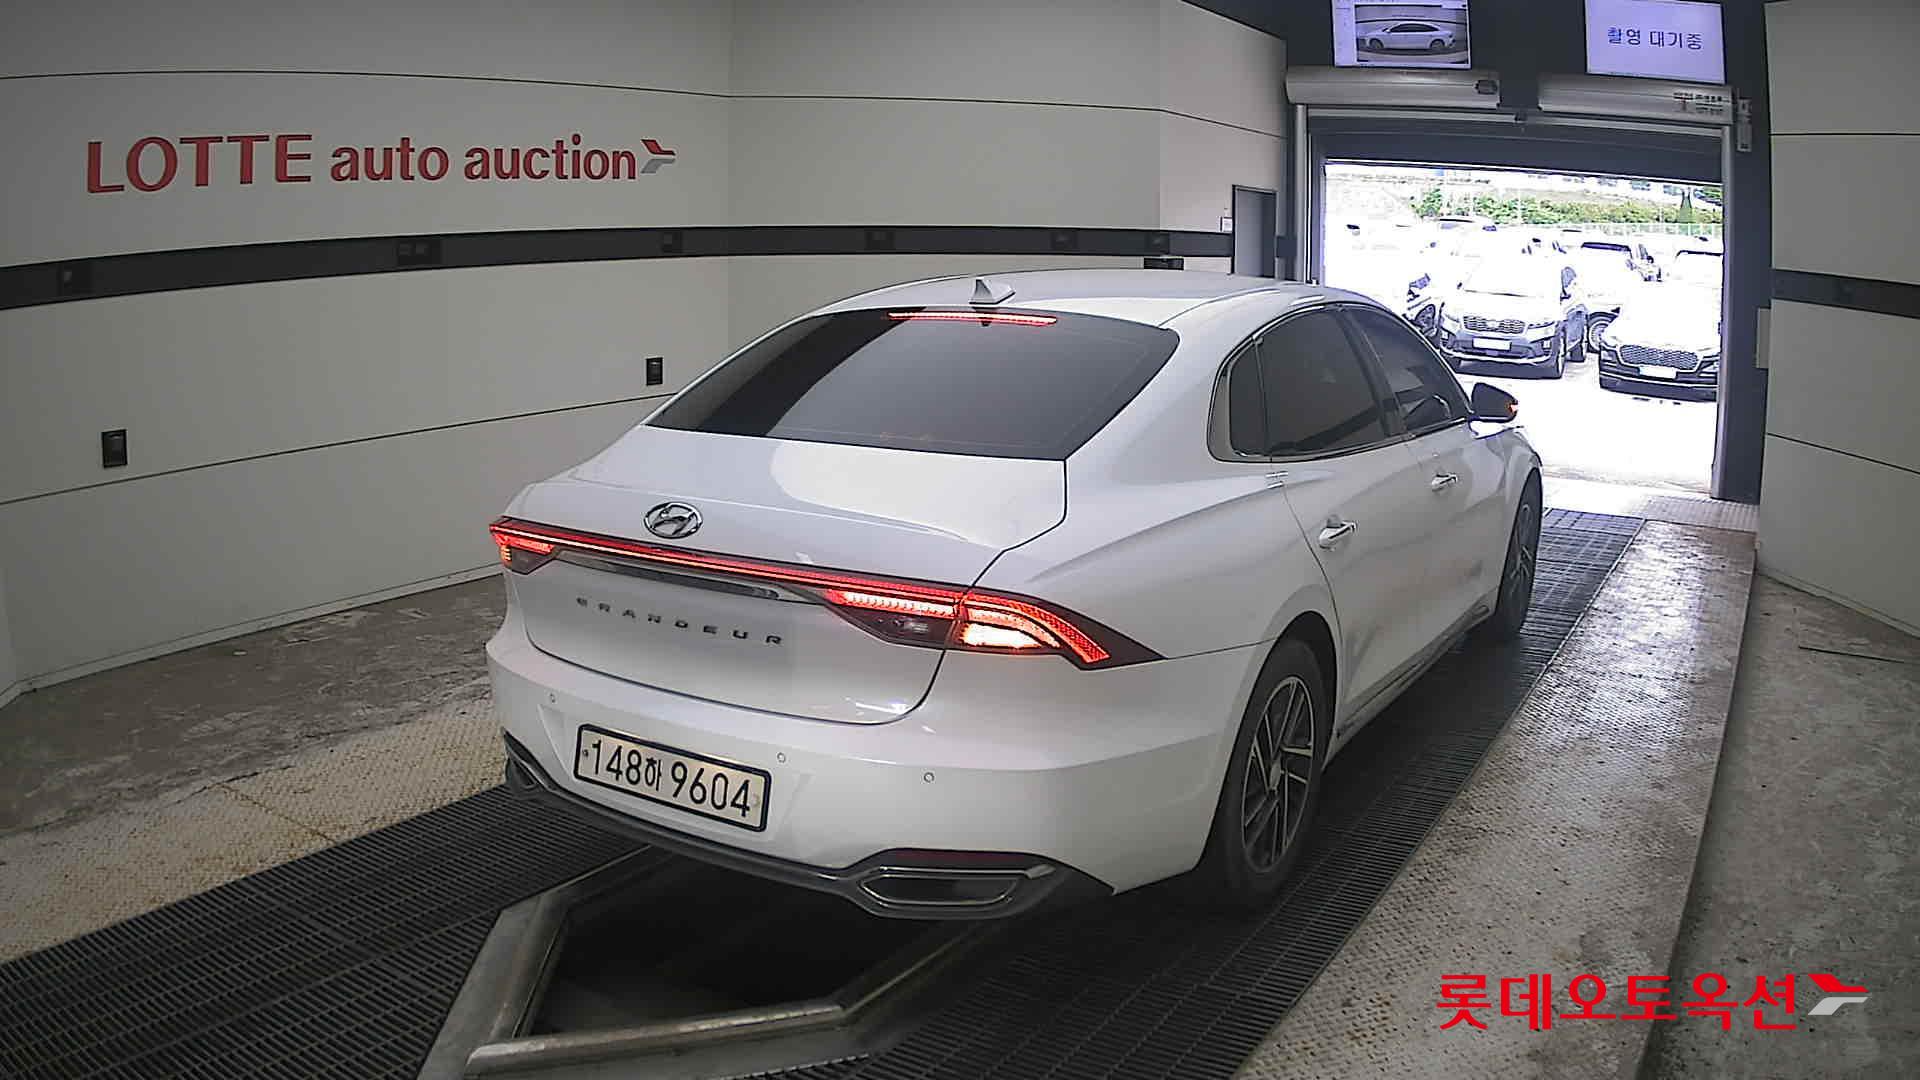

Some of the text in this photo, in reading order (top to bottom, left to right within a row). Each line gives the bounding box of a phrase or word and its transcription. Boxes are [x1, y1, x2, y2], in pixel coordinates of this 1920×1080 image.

[1649, 30, 1702, 50] 대기중
[87, 133, 636, 193] LOTTE auto auction
[576, 597, 782, 644] GRANDEUR
[591, 739, 750, 817] 148하 9604
